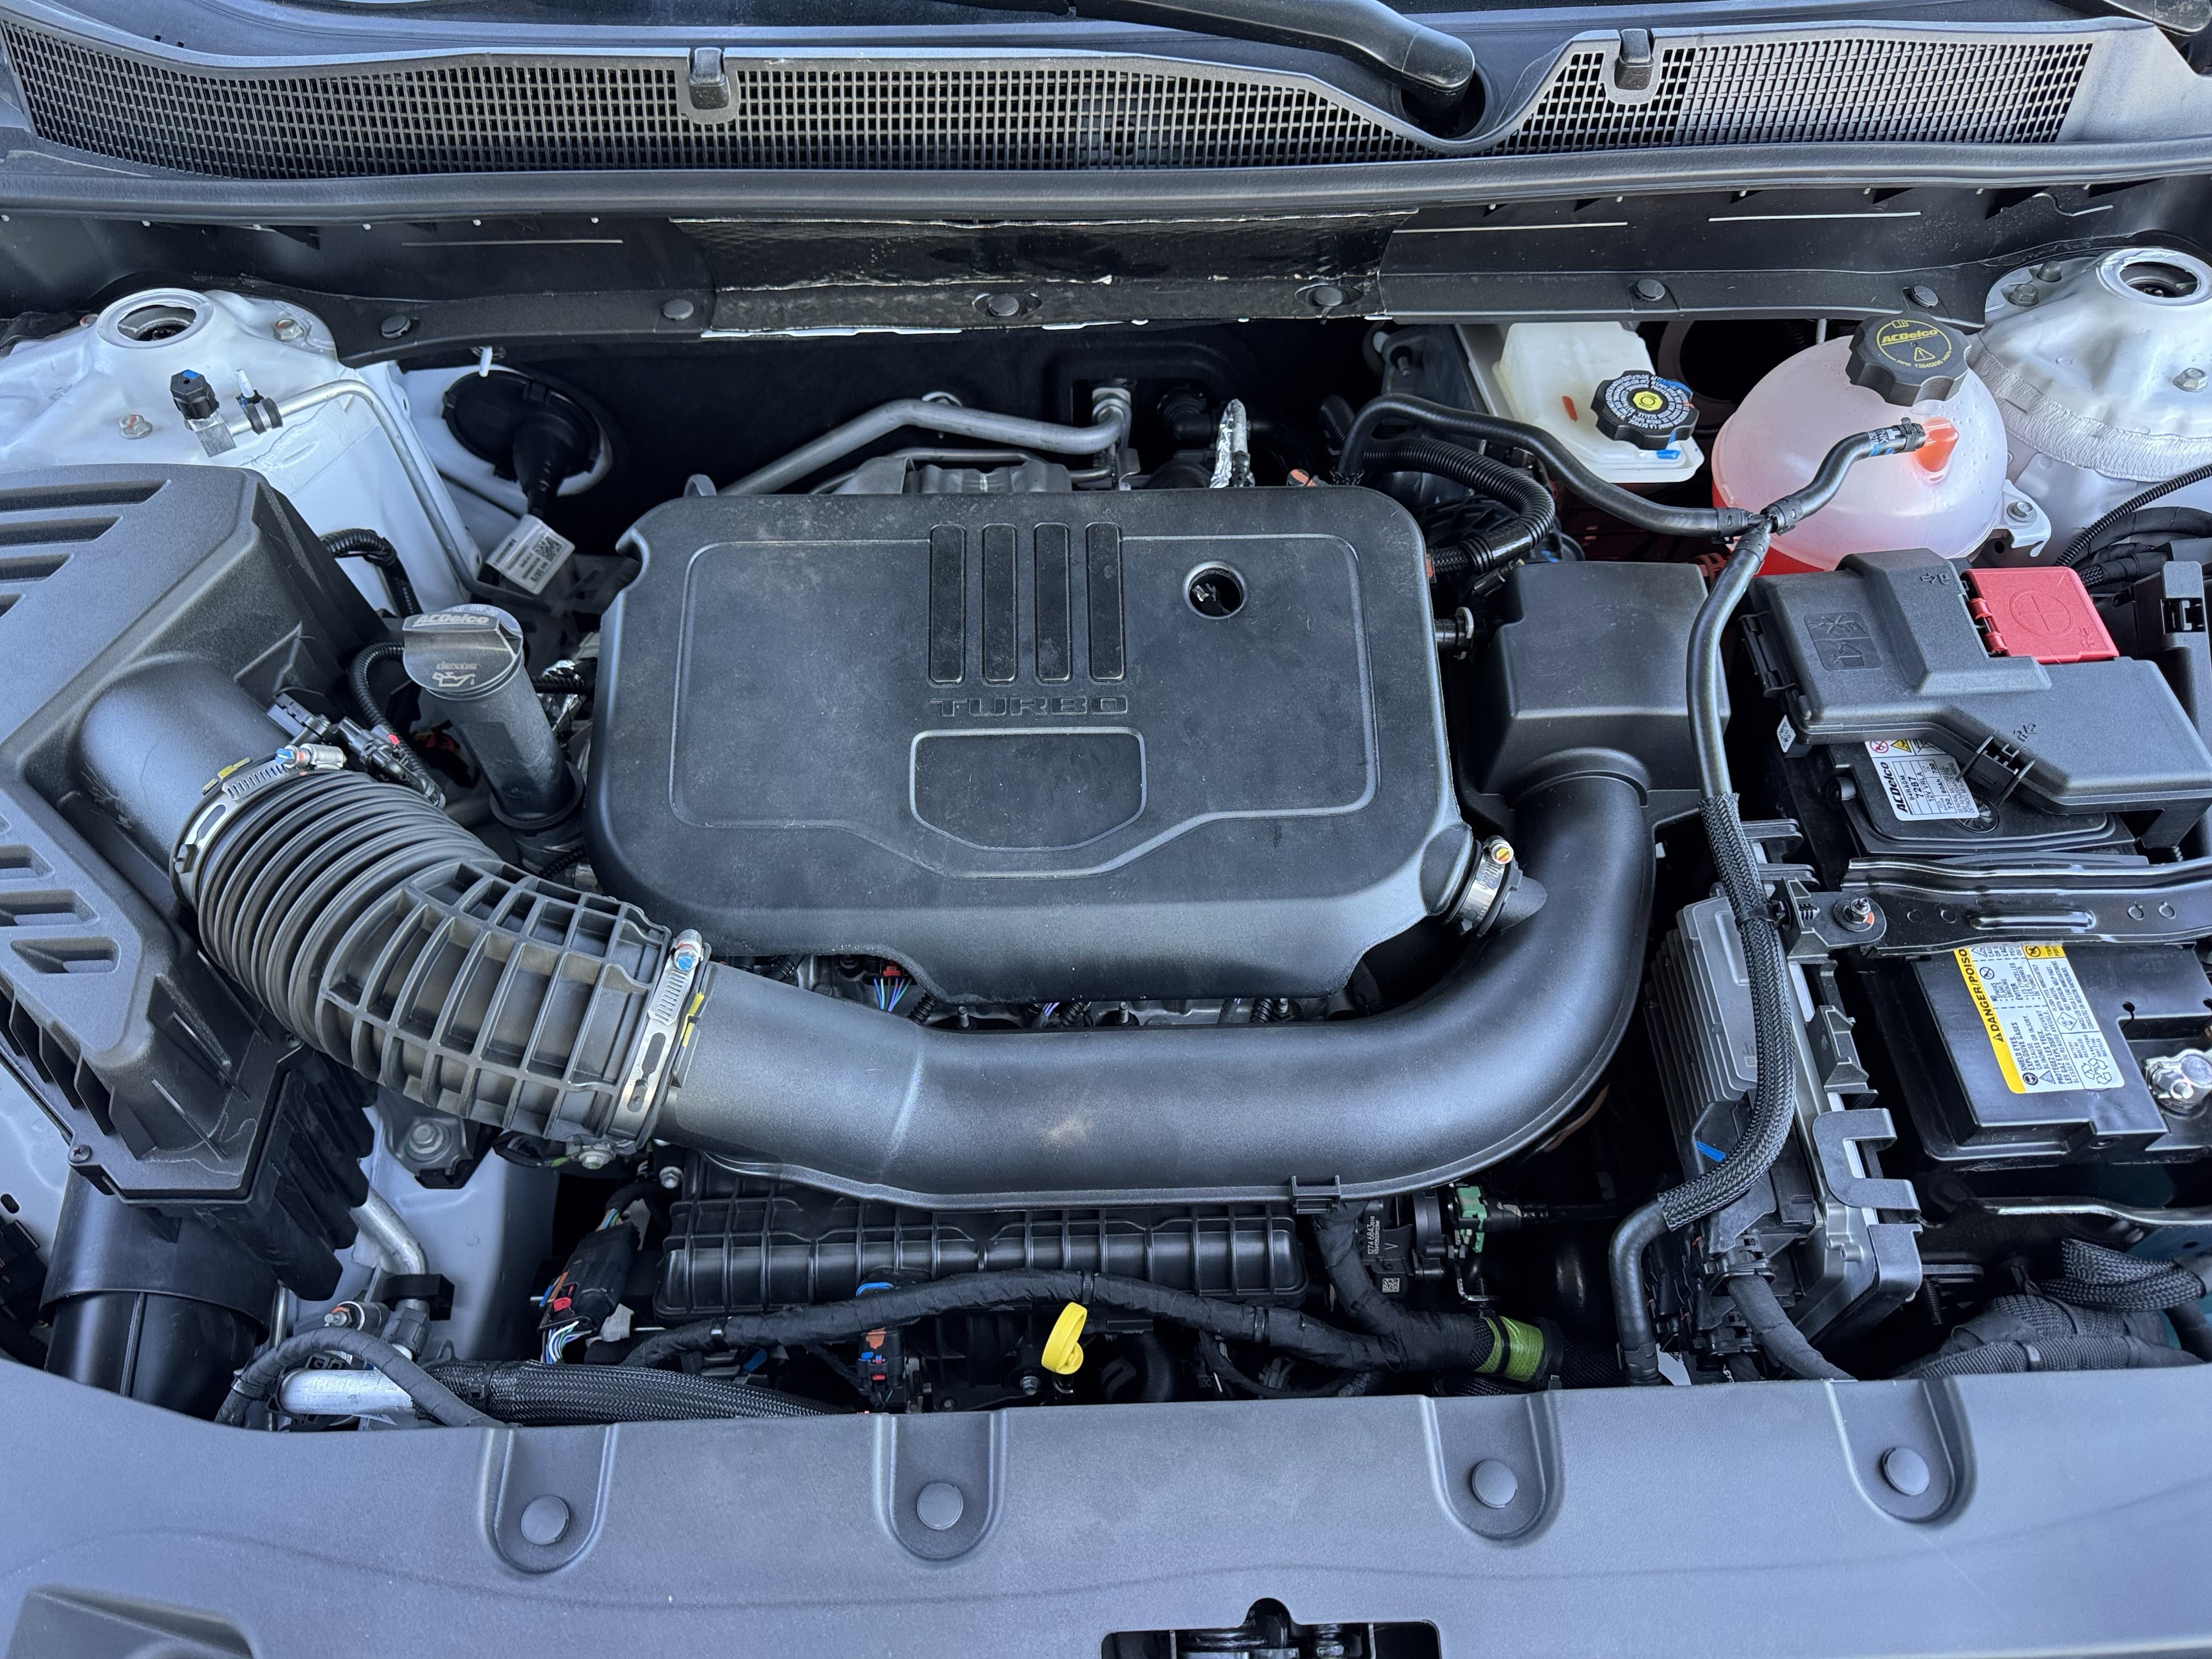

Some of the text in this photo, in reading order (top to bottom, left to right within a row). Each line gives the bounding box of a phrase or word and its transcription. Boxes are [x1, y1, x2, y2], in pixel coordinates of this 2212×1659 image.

[1882, 330, 1938, 343] ACDelco
[413, 614, 489, 624] ACDelco
[930, 697, 1127, 717] TURBO
[1881, 762, 1908, 812] ACDelco
[1900, 775, 1915, 800] 94RAGM
[1908, 777, 1923, 798] 7287
[1917, 772, 1934, 802] 12V VRLA
[1929, 763, 1953, 809] 730 80Ah 730
[1953, 794, 1965, 813] GENERAL
[2017, 966, 2029, 988] FLAMMES
[2027, 974, 2036, 989] FUMER
[2051, 977, 2059, 986] HELP
[1959, 949, 1999, 1031] DANGER/POISO
[1991, 983, 2002, 998] SPARKS
[1996, 982, 2008, 998] FLAMES
[2001, 979, 2013, 997] SMOKING
[2011, 983, 2023, 1000] ÉVITER
[2021, 989, 2029, 997] LES
[2043, 989, 2052, 998] EYES
[2057, 987, 2067, 1002] MEDICAL
[2023, 1015, 2034, 1033] INJURY.
[2043, 1012, 2057, 1032] AVEUGLE.
[2010, 1035, 2028, 1071] SHIELD EYES.
[2011, 1022, 2035, 1070] EXPLOSIVE GASES
[2036, 1011, 2073, 1084] LES GAZ EXPLOSIFS PEUVENT
[2053, 1034, 2065, 1053] RENDRE
[2078, 1039, 2089, 1058] RECYCLED
[2027, 1043, 2042, 1070] CAN CAUSE
[2034, 1042, 2050, 1069] BLINDNESS
[2037, 1029, 2065, 1084] PROTÉGEZ LES YEUX.
[2066, 1062, 2079, 1084] BLESSER
